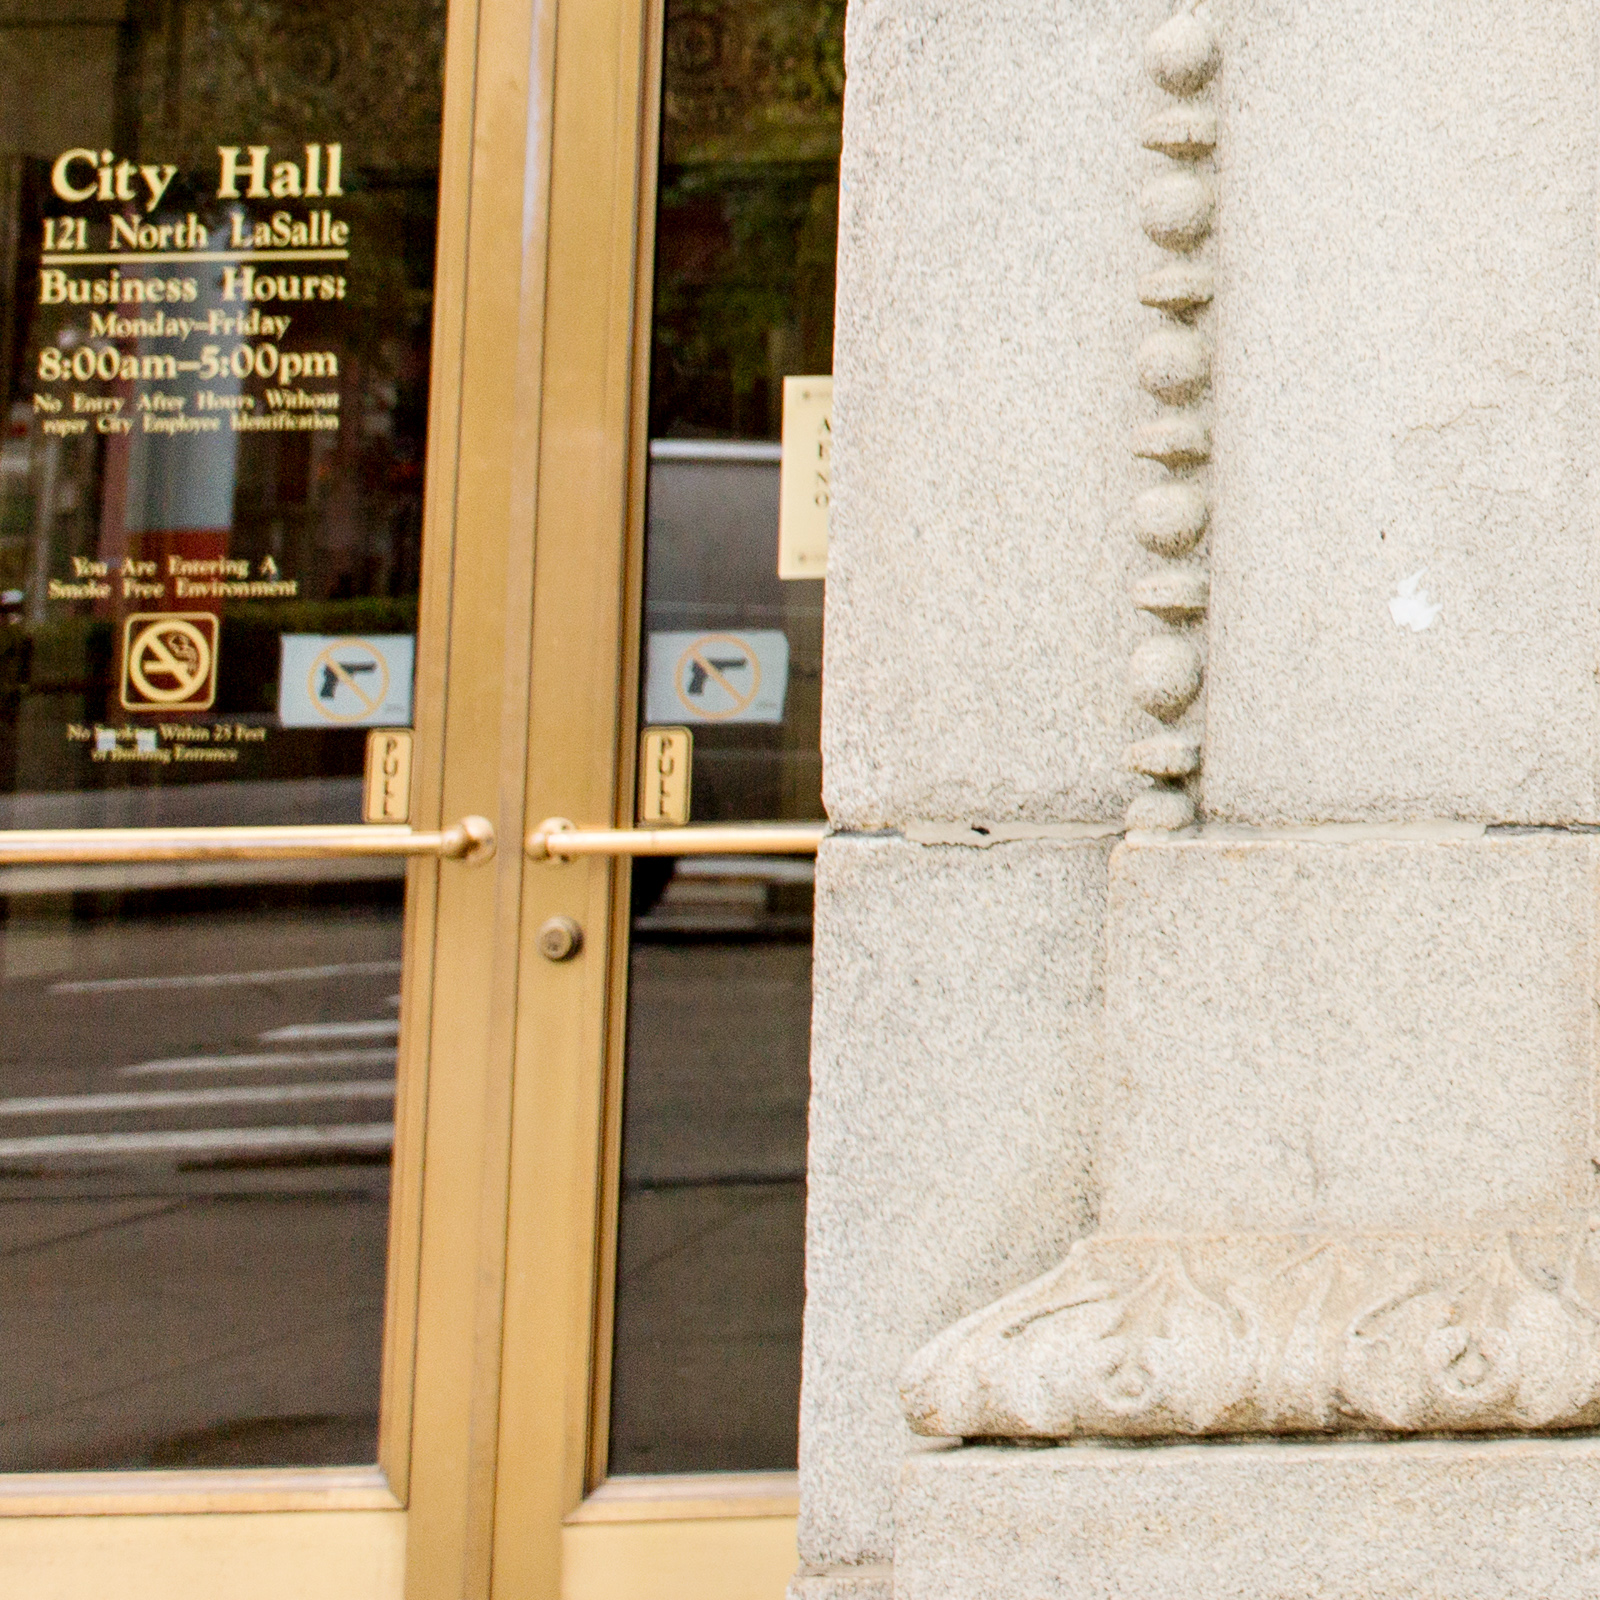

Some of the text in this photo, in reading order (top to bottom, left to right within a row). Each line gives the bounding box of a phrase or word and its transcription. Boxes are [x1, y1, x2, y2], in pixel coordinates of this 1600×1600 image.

[51, 142, 344, 212] City Hall
[42, 210, 350, 250] 121 North LaSalle
[39, 266, 347, 305] Business Hours:
[34, 388, 340, 415] No Entry After Hours Without
[97, 414, 133, 436] City
[72, 554, 279, 579] You Are Entering A
[48, 578, 298, 600] Smoke Free Environment
[382, 737, 399, 816] PULL
[657, 736, 674, 818] PULL
